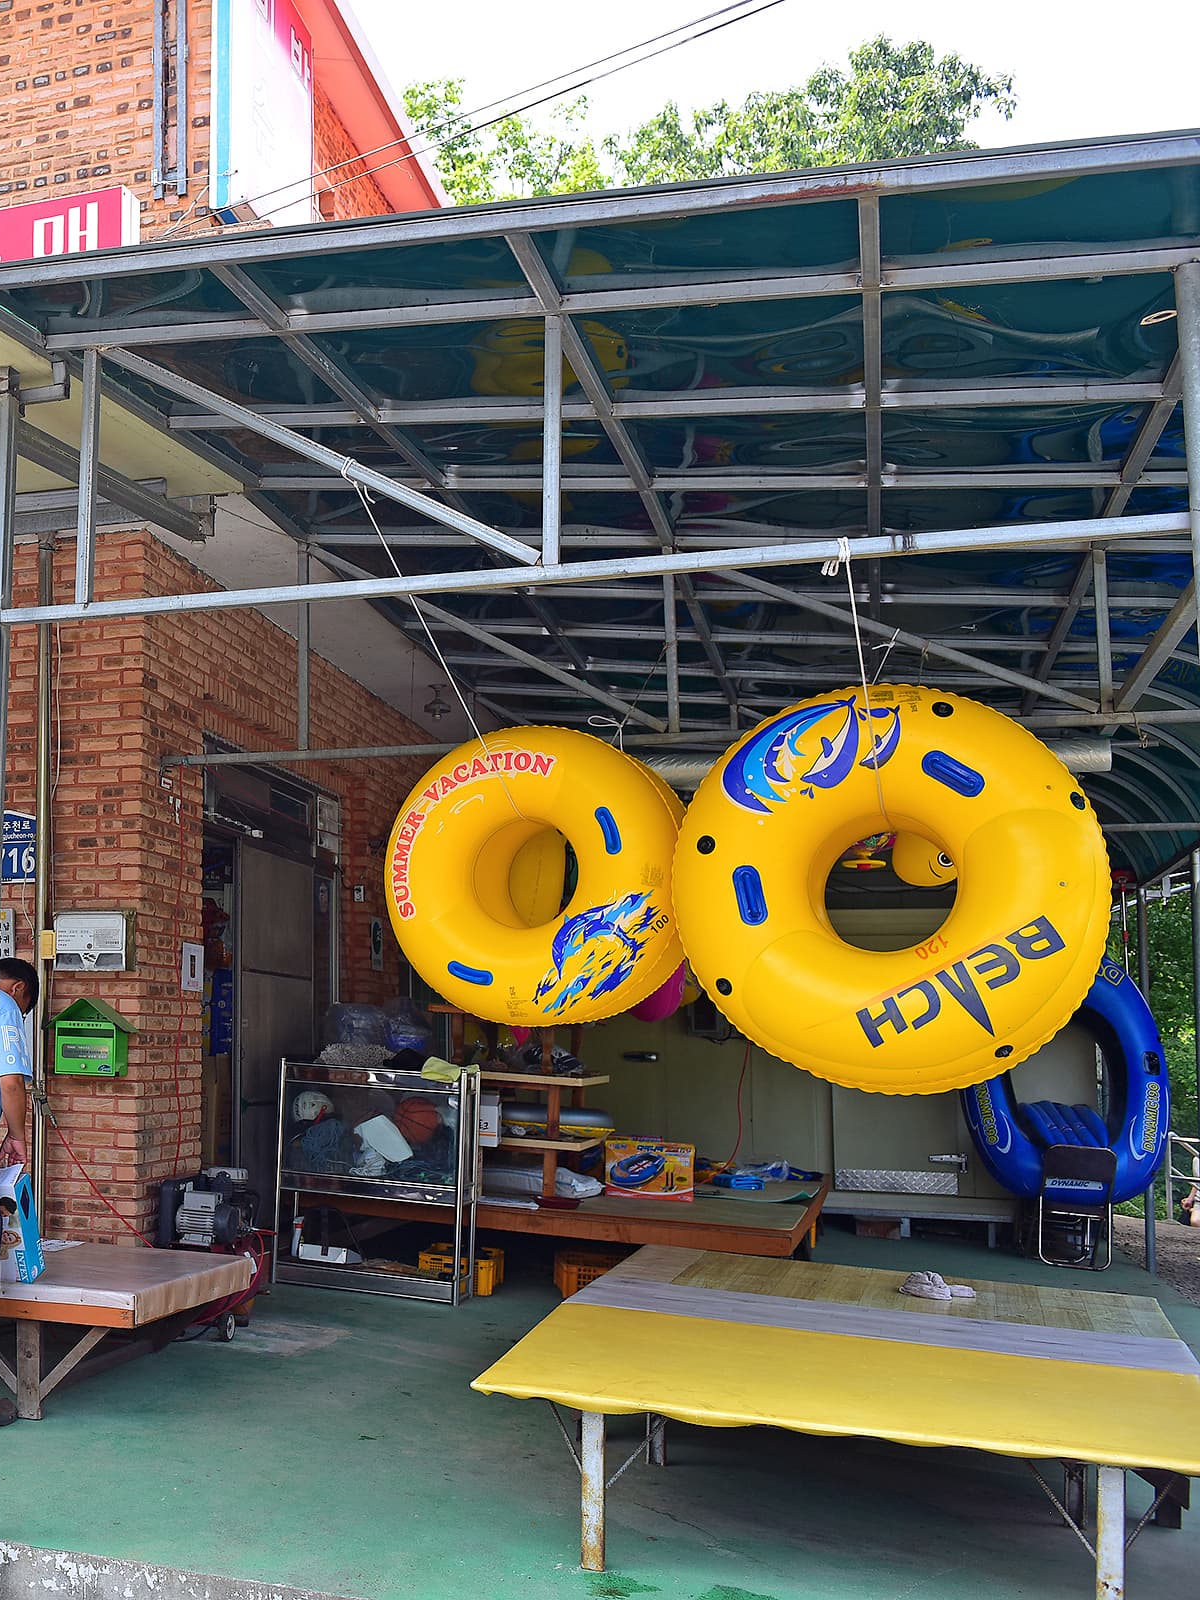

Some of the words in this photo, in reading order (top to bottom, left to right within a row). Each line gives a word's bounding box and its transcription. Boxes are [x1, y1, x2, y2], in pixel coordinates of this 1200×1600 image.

[2, 820, 31, 832] 주천로
[391, 809, 426, 919] SUMMER
[422, 751, 556, 802] VACATION
[1, 847, 36, 874] 16
[650, 914, 670, 935] 100
[914, 934, 949, 960] 120
[855, 915, 1066, 1048] BEACH
[1050, 1179, 1090, 1188] DYNAMIC
[16, 1251, 29, 1281] INTEX
